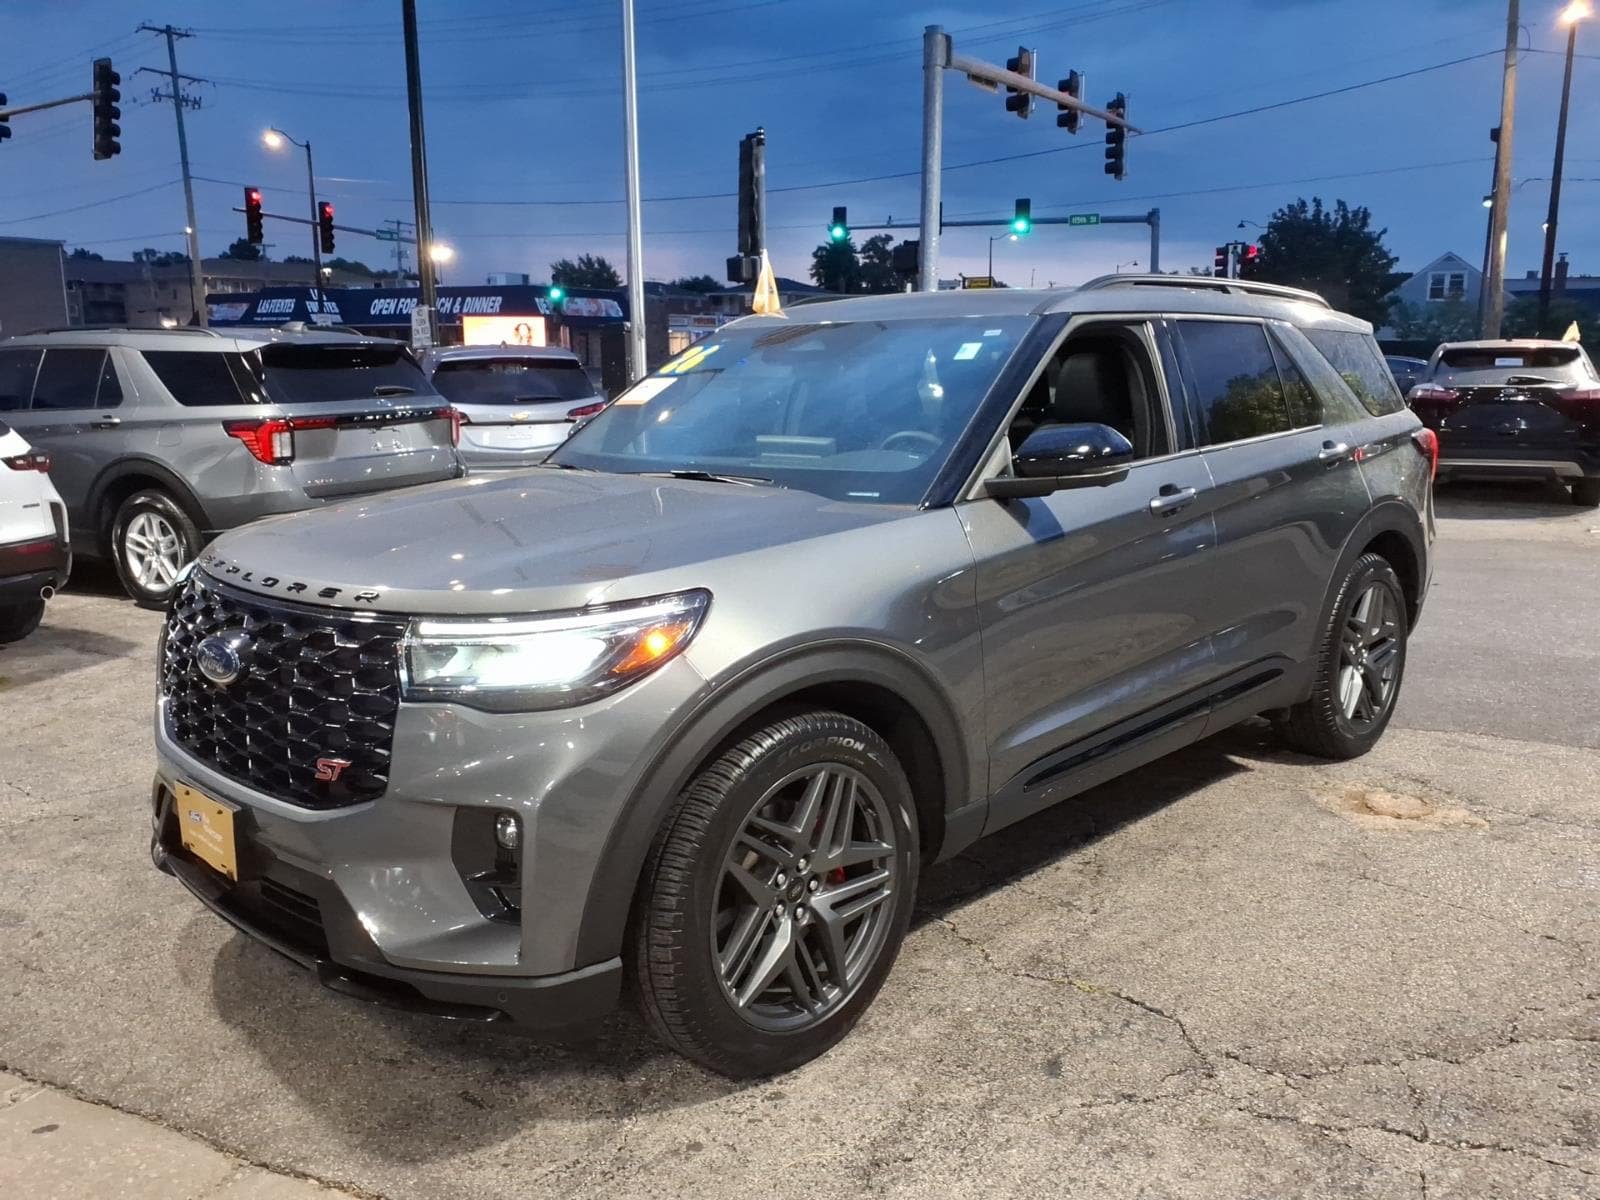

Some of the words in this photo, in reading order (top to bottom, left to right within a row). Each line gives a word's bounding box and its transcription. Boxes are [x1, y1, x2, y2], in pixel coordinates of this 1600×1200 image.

[370, 299, 398, 315] OPEN
[453, 297, 462, 313] &
[462, 296, 503, 313] DINNER
[314, 757, 352, 781] ST
